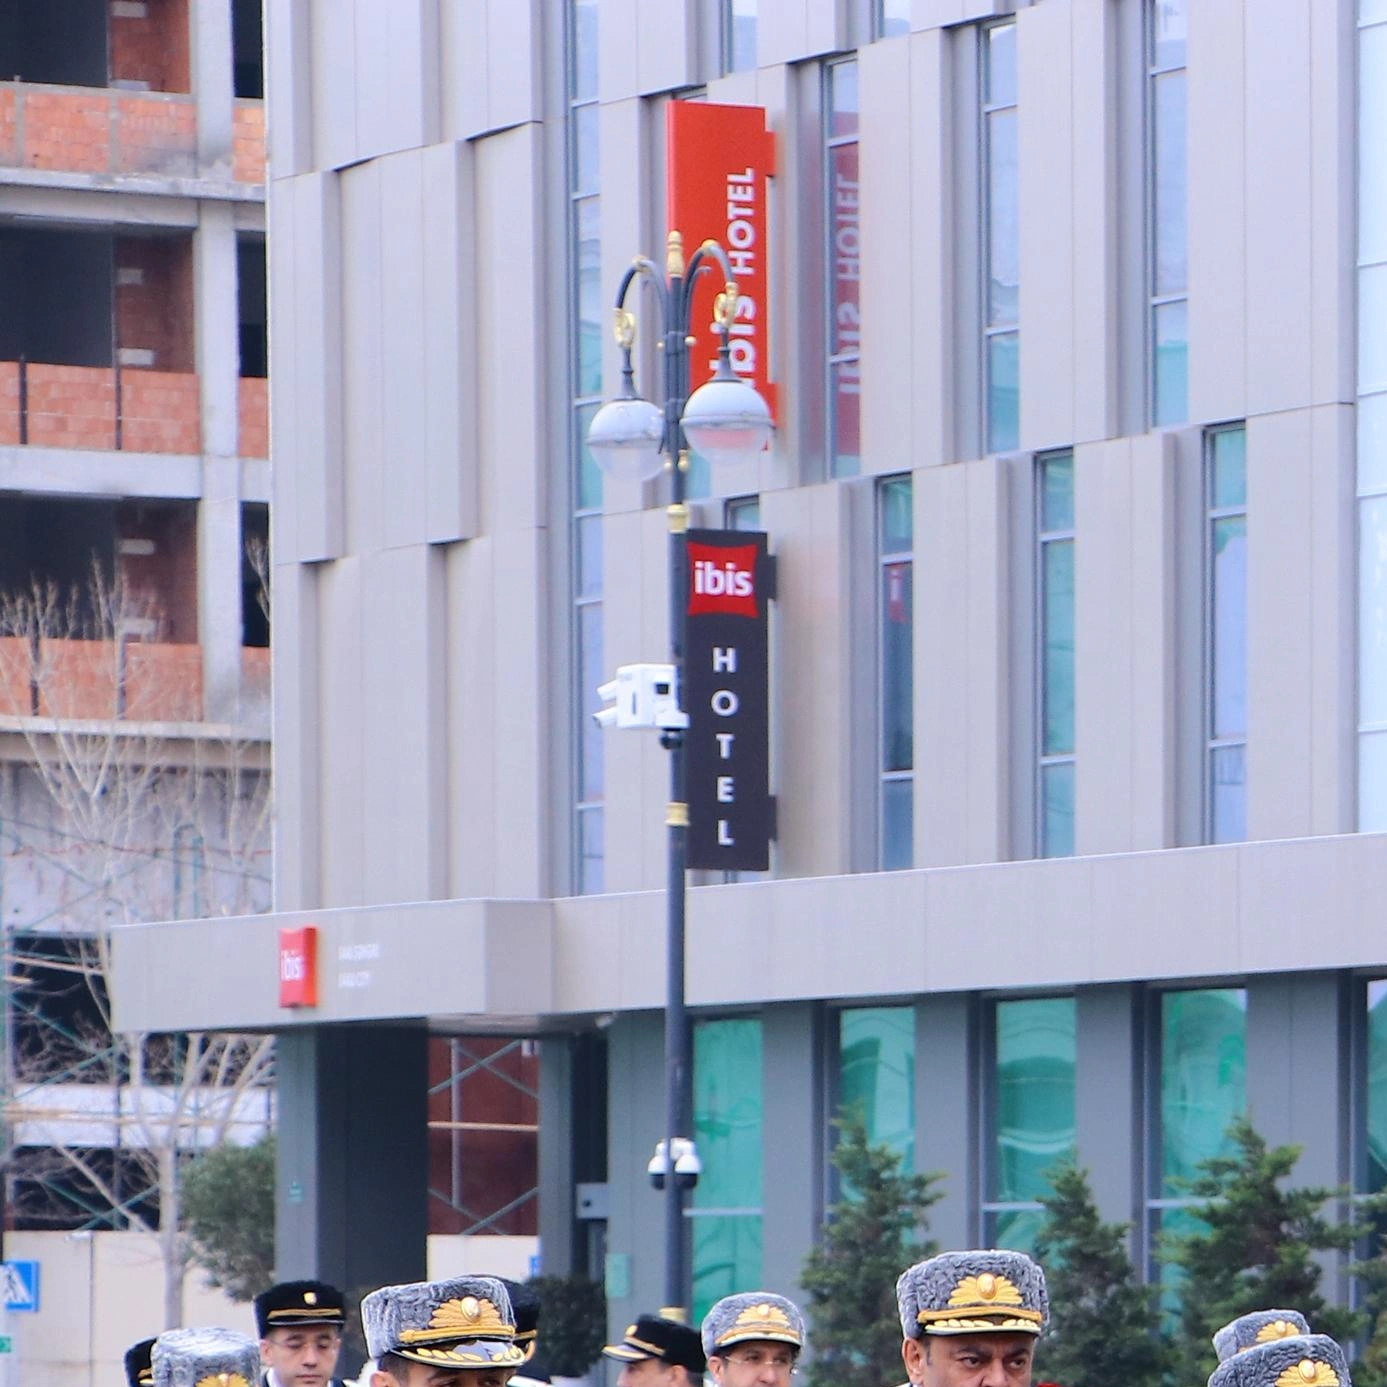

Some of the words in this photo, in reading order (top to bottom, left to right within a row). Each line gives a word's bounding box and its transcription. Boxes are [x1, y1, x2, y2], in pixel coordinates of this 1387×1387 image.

[727, 167, 756, 276] HOTEL
[709, 296, 756, 388] bis
[695, 561, 753, 596] ibis
[711, 647, 739, 845] HOTEL
